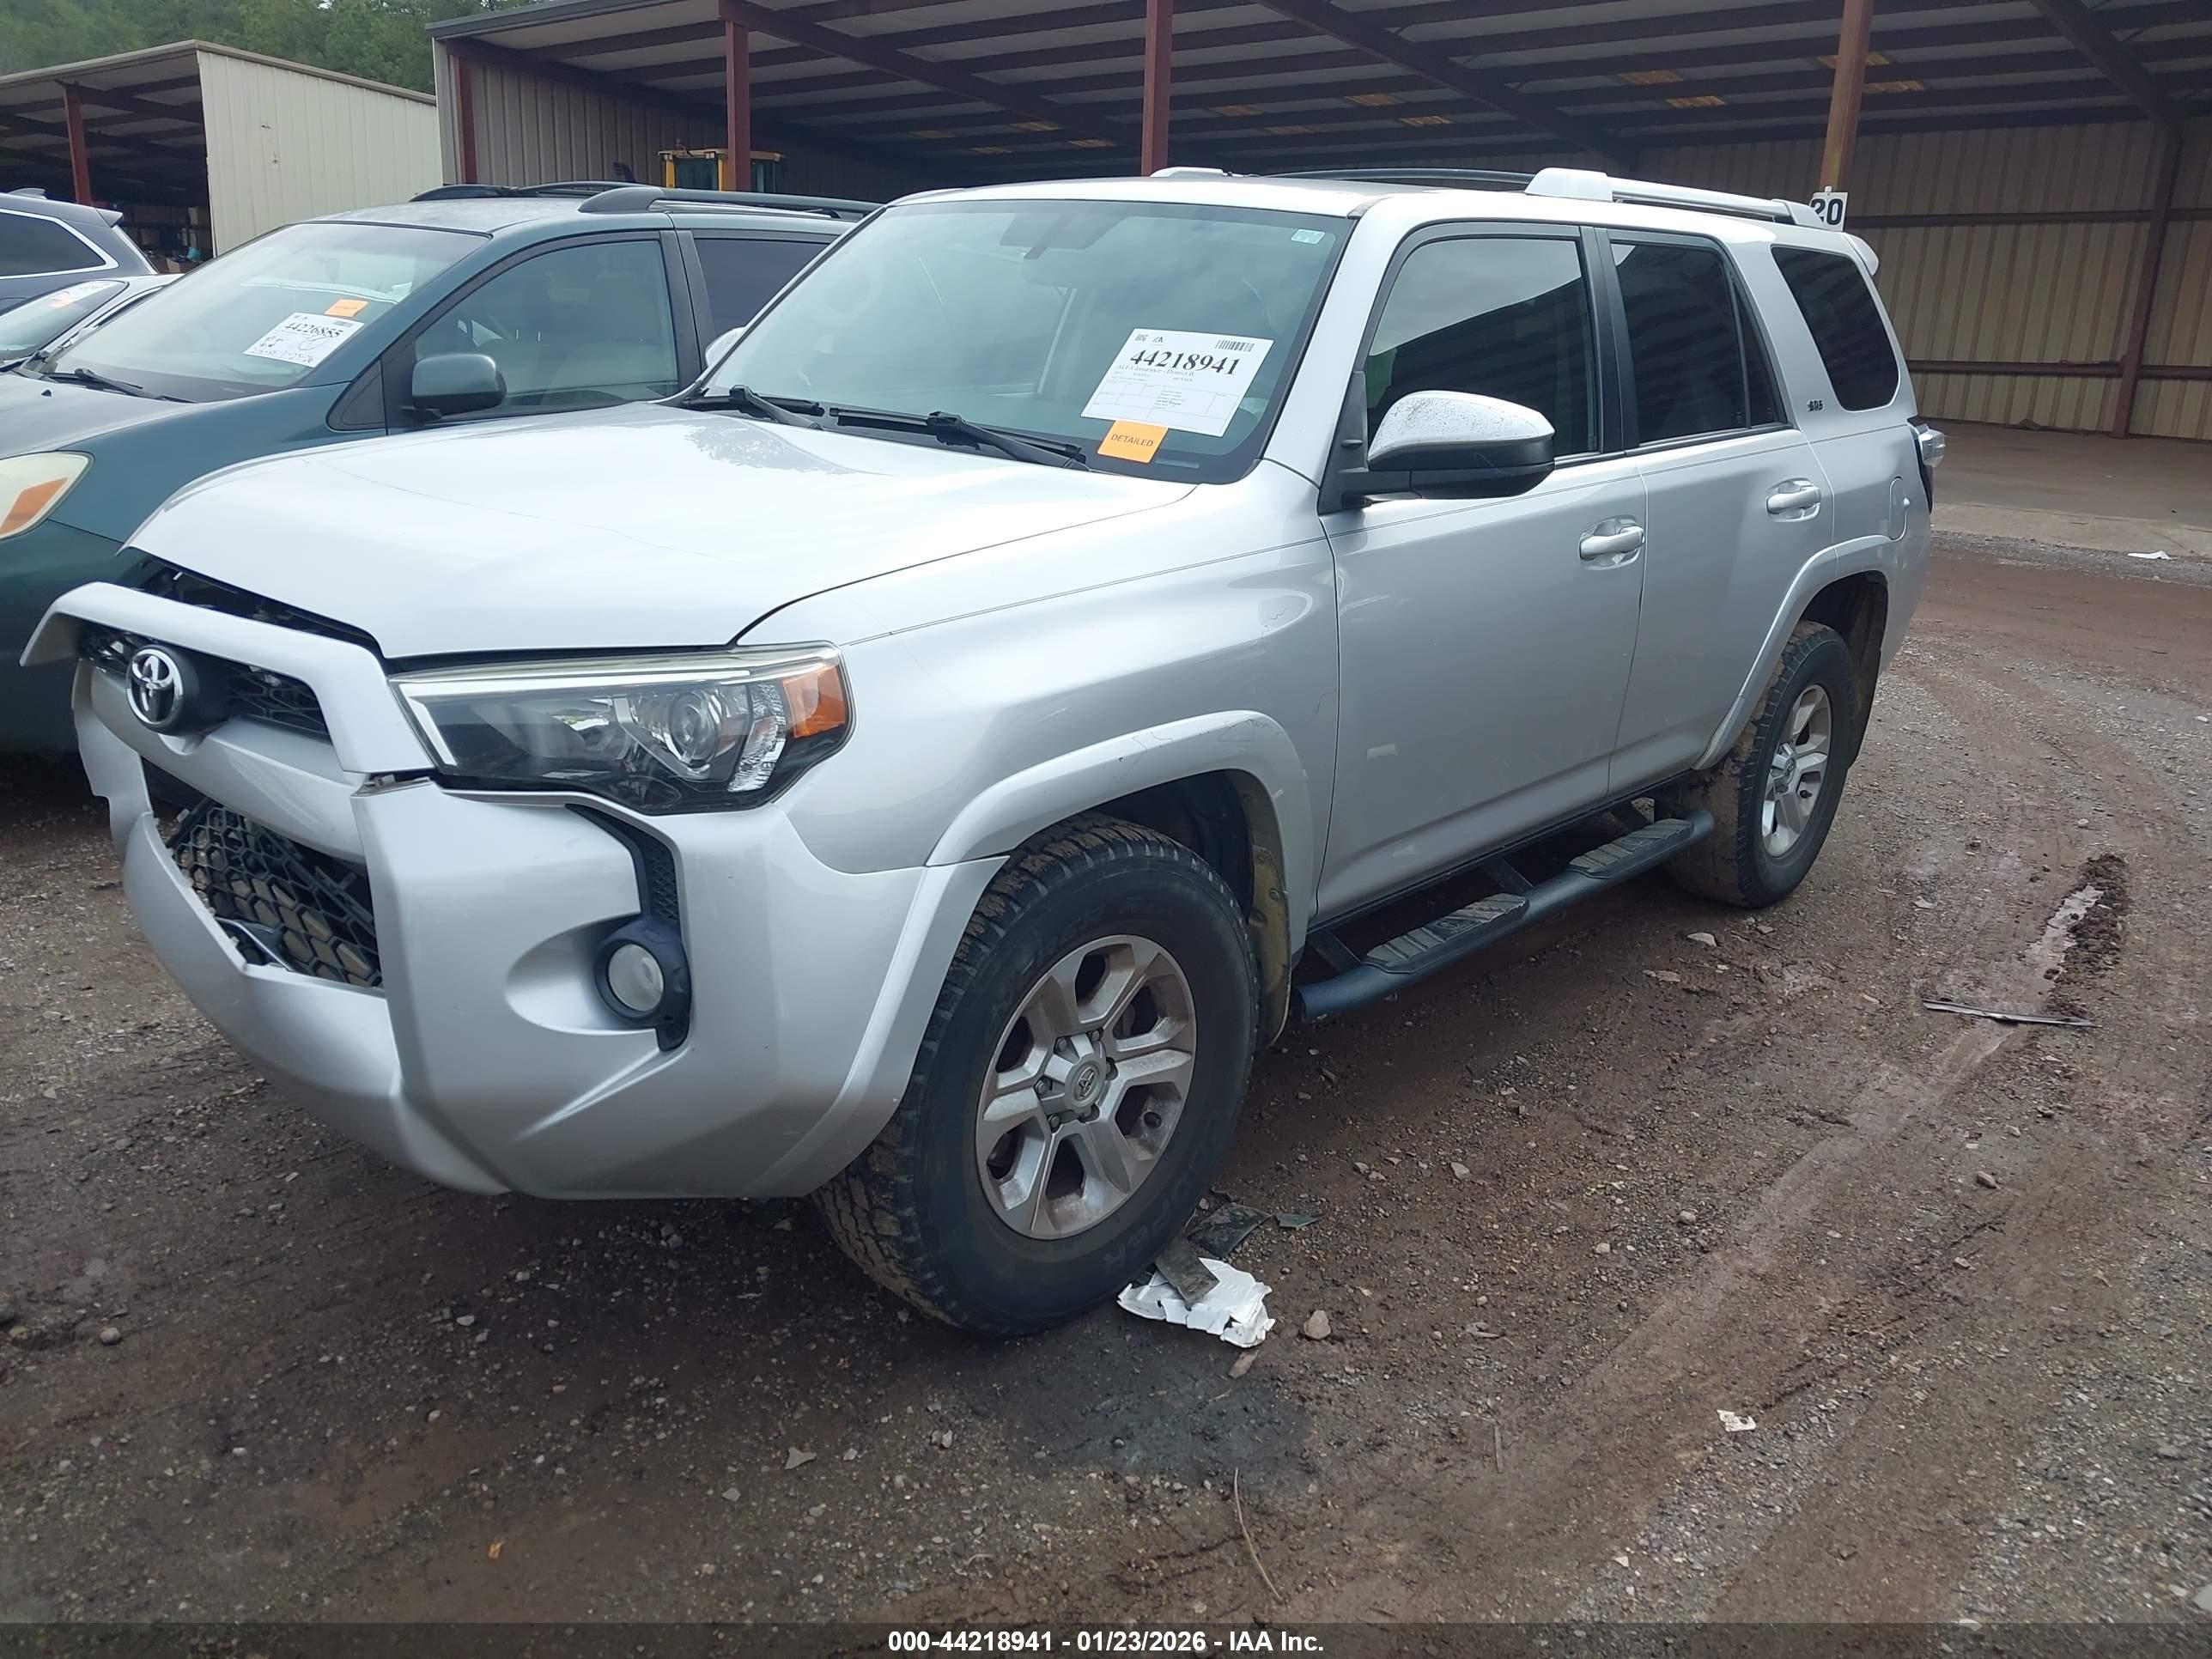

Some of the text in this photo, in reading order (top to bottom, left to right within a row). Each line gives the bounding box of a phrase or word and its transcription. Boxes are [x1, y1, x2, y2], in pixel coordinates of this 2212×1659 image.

[1811, 198, 1843, 225] 20
[1130, 349, 1241, 375] 44218941
[1110, 433, 1154, 447] DETAILED
